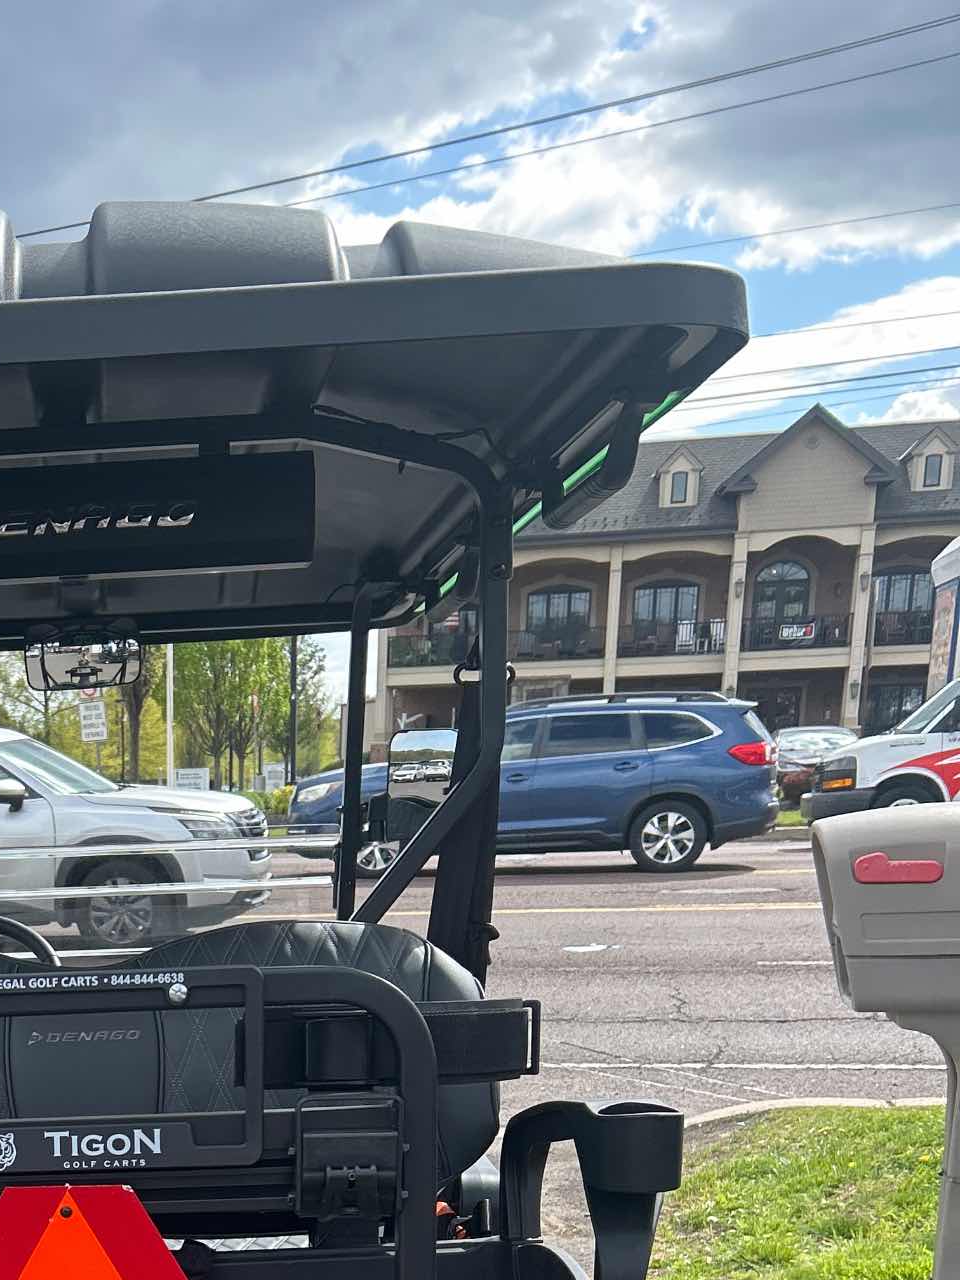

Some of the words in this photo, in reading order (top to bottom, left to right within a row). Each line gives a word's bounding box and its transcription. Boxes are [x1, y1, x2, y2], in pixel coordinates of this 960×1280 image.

[28, 976, 59, 989] GOLF
[61, 975, 99, 988] CARTS
[111, 972, 184, 986] 844-844-6638
[45, 1029, 141, 1043] DENAGO
[44, 1128, 162, 1157] TIGON
[63, 1160, 97, 1169] GOLF
[103, 1159, 146, 1168] CARTS
